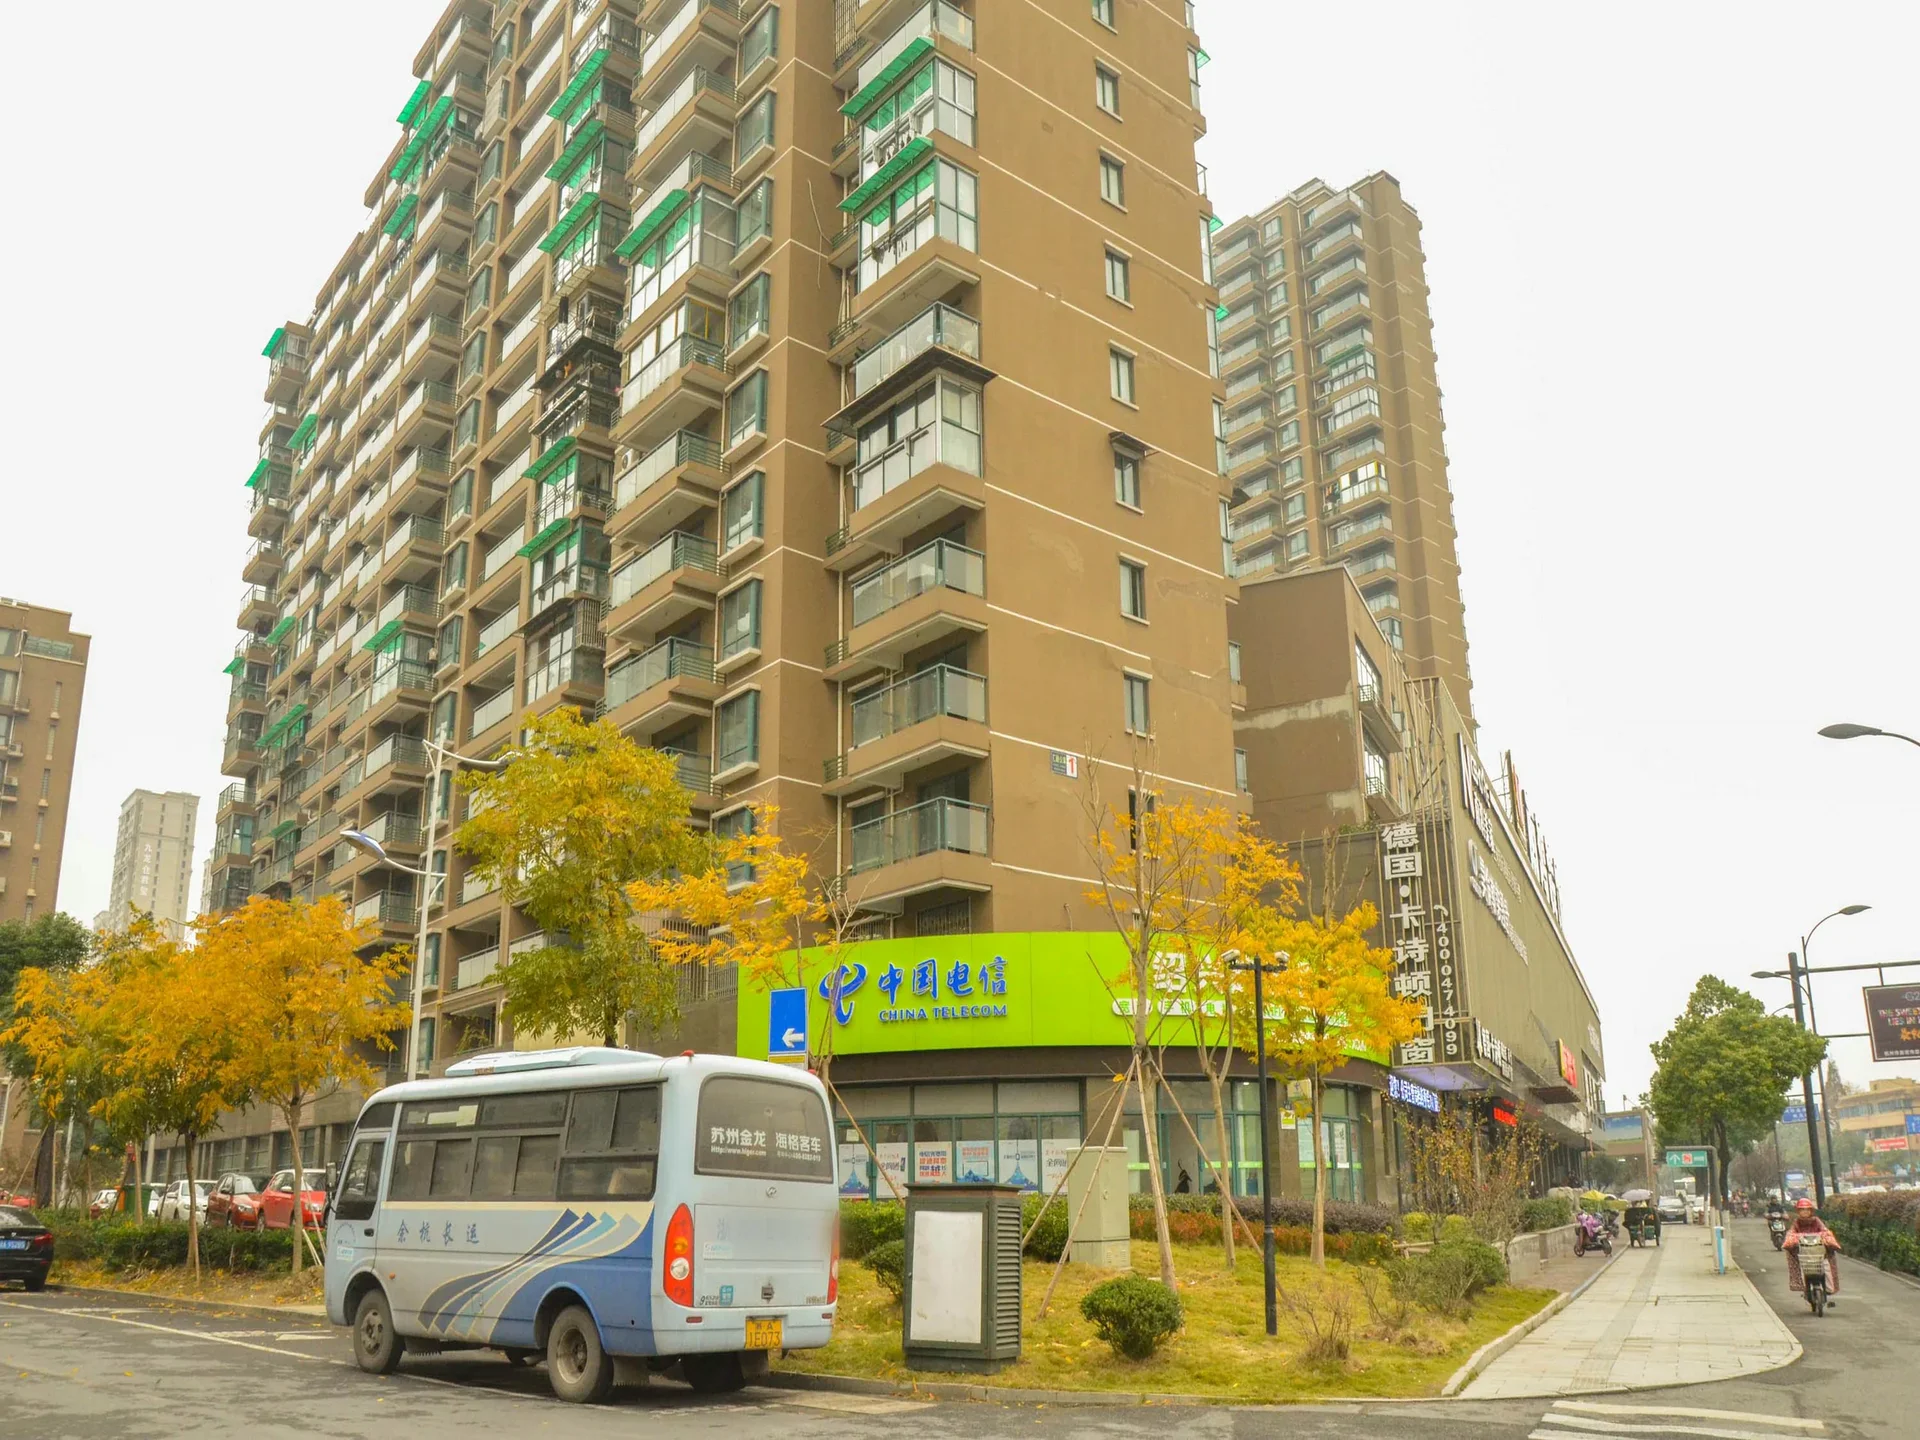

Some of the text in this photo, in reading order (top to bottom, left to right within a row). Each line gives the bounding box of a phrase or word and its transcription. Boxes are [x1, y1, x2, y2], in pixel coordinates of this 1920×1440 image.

[878, 956, 1008, 1006] 中国电信
[879, 1004, 1008, 1023] CHINA TELECOM
[710, 1127, 821, 1153] 苏州金龙 海格客车
